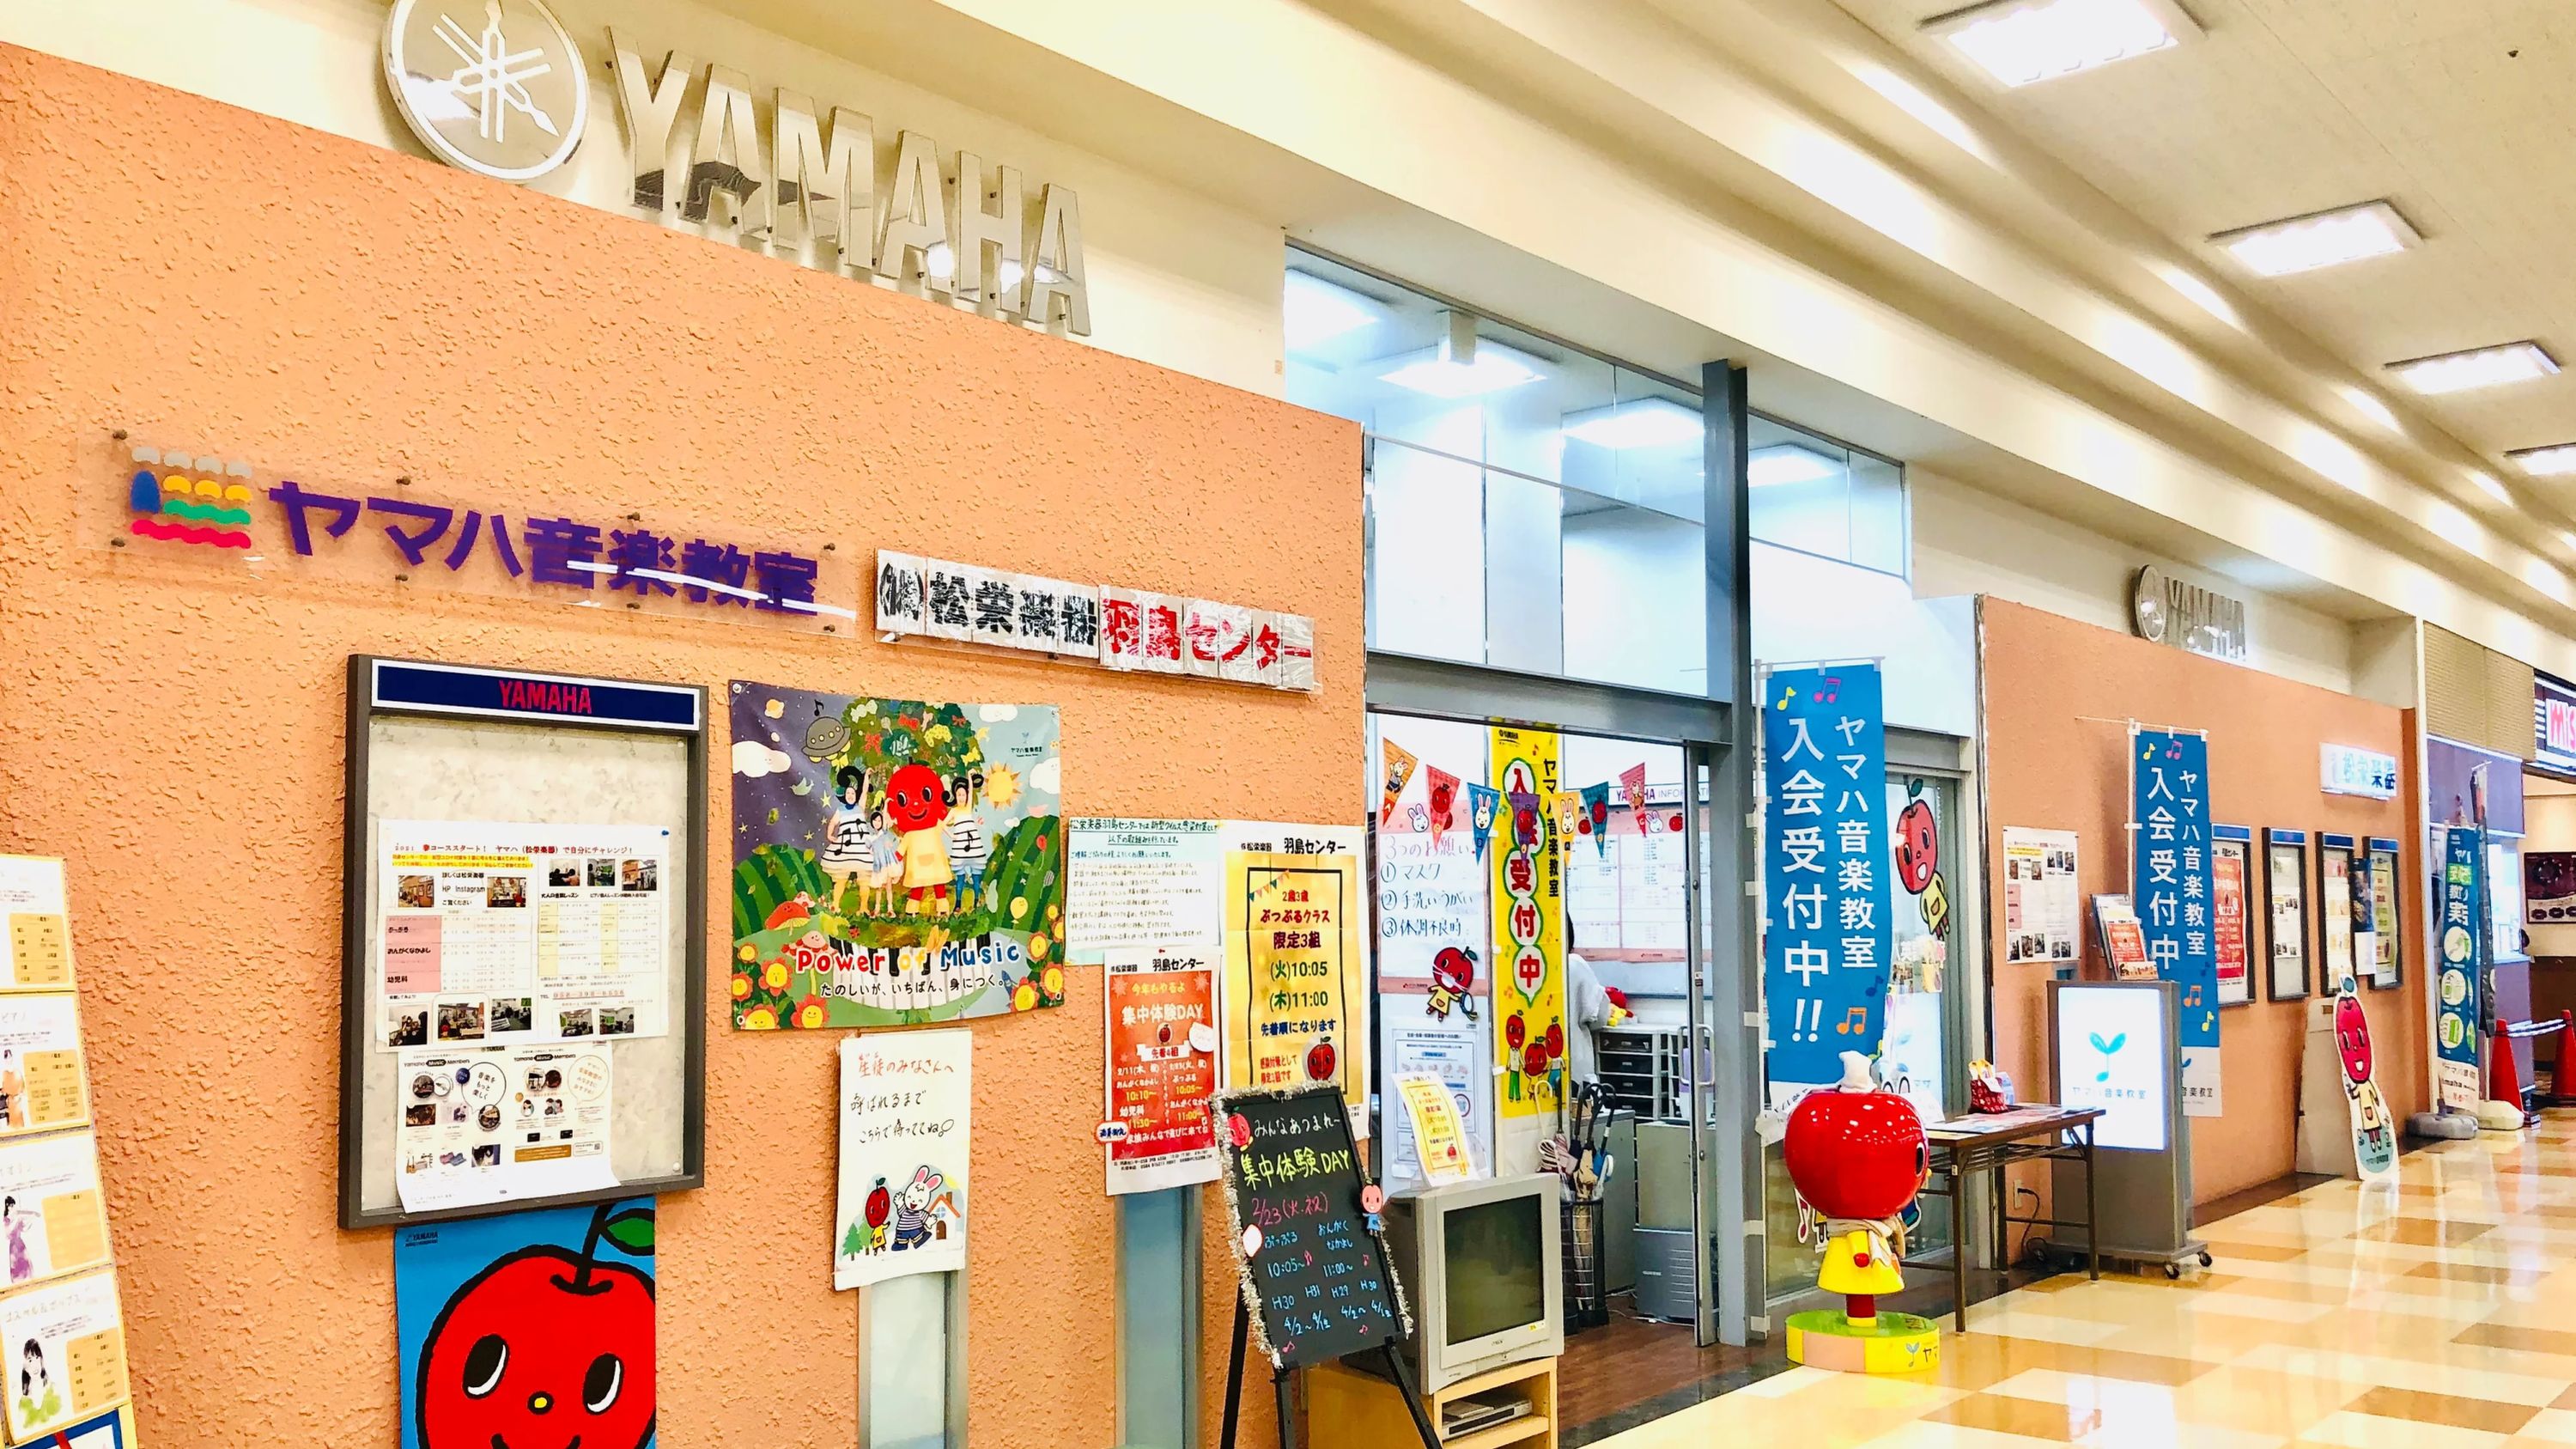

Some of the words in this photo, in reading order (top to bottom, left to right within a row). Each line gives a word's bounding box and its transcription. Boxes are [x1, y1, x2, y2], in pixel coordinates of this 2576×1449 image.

[604, 25, 1091, 336] YAMAHA
[268, 480, 817, 617] ヤマハ音楽教室
[499, 679, 592, 715] YAMAHA
[1284, 837, 1346, 854] 羽島センター
[1835, 715, 1878, 968] ヤマハ音楽教室
[2148, 767, 2179, 971] 入会受付中
[2178, 770, 2207, 957] ヤマハ音楽教室
[1273, 931, 1321, 949] 限定3組
[796, 949, 885, 972] Power
[901, 949, 926, 971] of
[941, 941, 1020, 967] Music
[1152, 959, 1204, 971] 羽島センター
[1132, 981, 1185, 995] 今年もやるよ
[1261, 1019, 1336, 1037] 先着順になります
[1305, 1285, 1320, 1298] H31
[1331, 1285, 1349, 1299] H29
[1360, 1280, 1376, 1291] H30
[1272, 1295, 1295, 1310] H30
